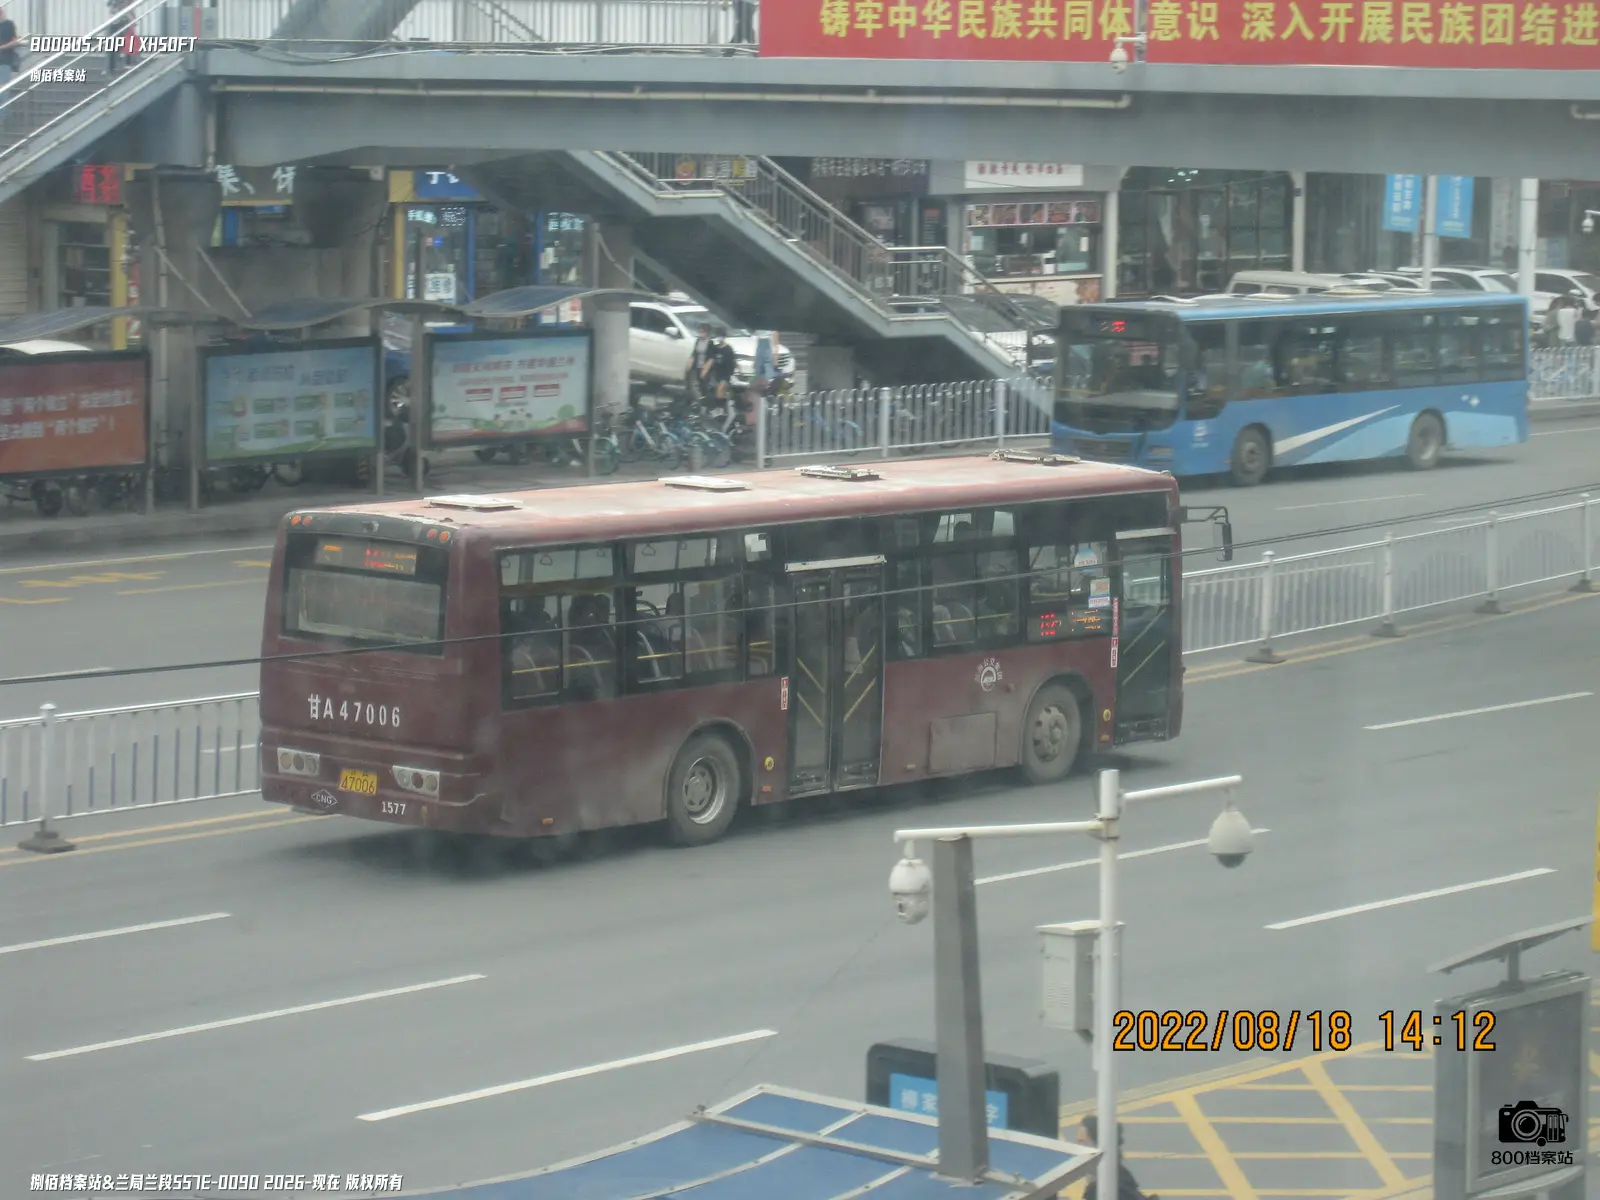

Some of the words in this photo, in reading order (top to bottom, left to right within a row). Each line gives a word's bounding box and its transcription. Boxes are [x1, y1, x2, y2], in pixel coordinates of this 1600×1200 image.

[819, 0, 1219, 41] 铸牢中华民族共同体意识
[1241, 2, 1600, 46] 深入开展民族团结进
[307, 693, 401, 728] 甘A47006
[341, 776, 375, 794] 47006
[316, 793, 333, 805] CNG
[381, 800, 406, 815] 1577
